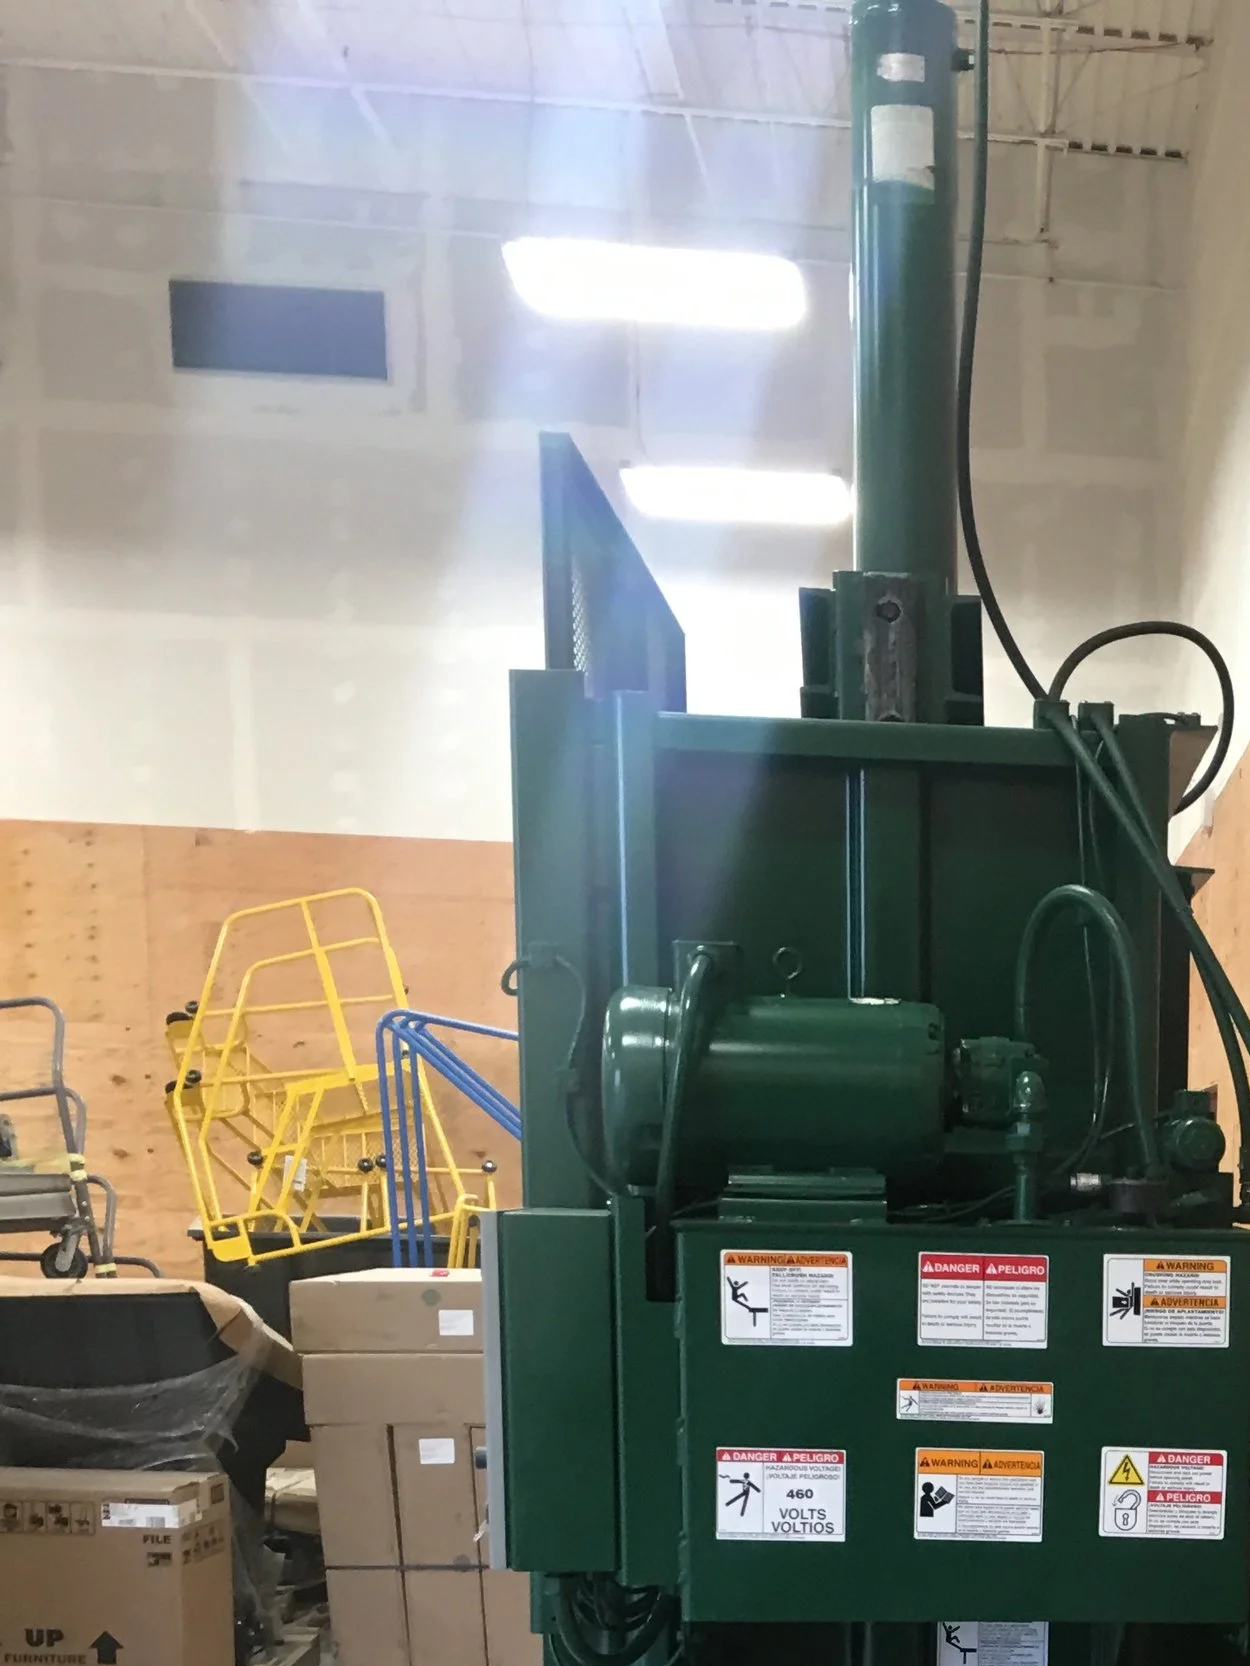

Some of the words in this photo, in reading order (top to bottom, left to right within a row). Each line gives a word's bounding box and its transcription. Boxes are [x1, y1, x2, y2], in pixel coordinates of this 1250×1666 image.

[738, 1255, 784, 1264] WARNING
[934, 1262, 980, 1273] DANGER
[998, 1264, 1045, 1275] PELIGRO
[1166, 1262, 1214, 1271] WARNING
[1161, 1297, 1219, 1307] ADVERTENCIA
[922, 1383, 959, 1391] WARNING
[990, 1384, 1044, 1393] ADVERTENCIA
[733, 1452, 777, 1461] DANGER
[793, 1453, 839, 1463] PELIGRO
[1167, 1454, 1211, 1464] DANGER
[931, 1459, 979, 1469] WARNING
[993, 1460, 1041, 1469] ADVERTENCIA
[786, 1488, 814, 1500] 460
[1166, 1492, 1211, 1503] PELIGRO
[779, 1508, 827, 1520] VOLTS
[771, 1521, 835, 1534] VOLTIOS
[143, 1534, 172, 1545] FILE
[24, 1628, 64, 1647] UP
[4, 1652, 87, 1665] FURNITURE
